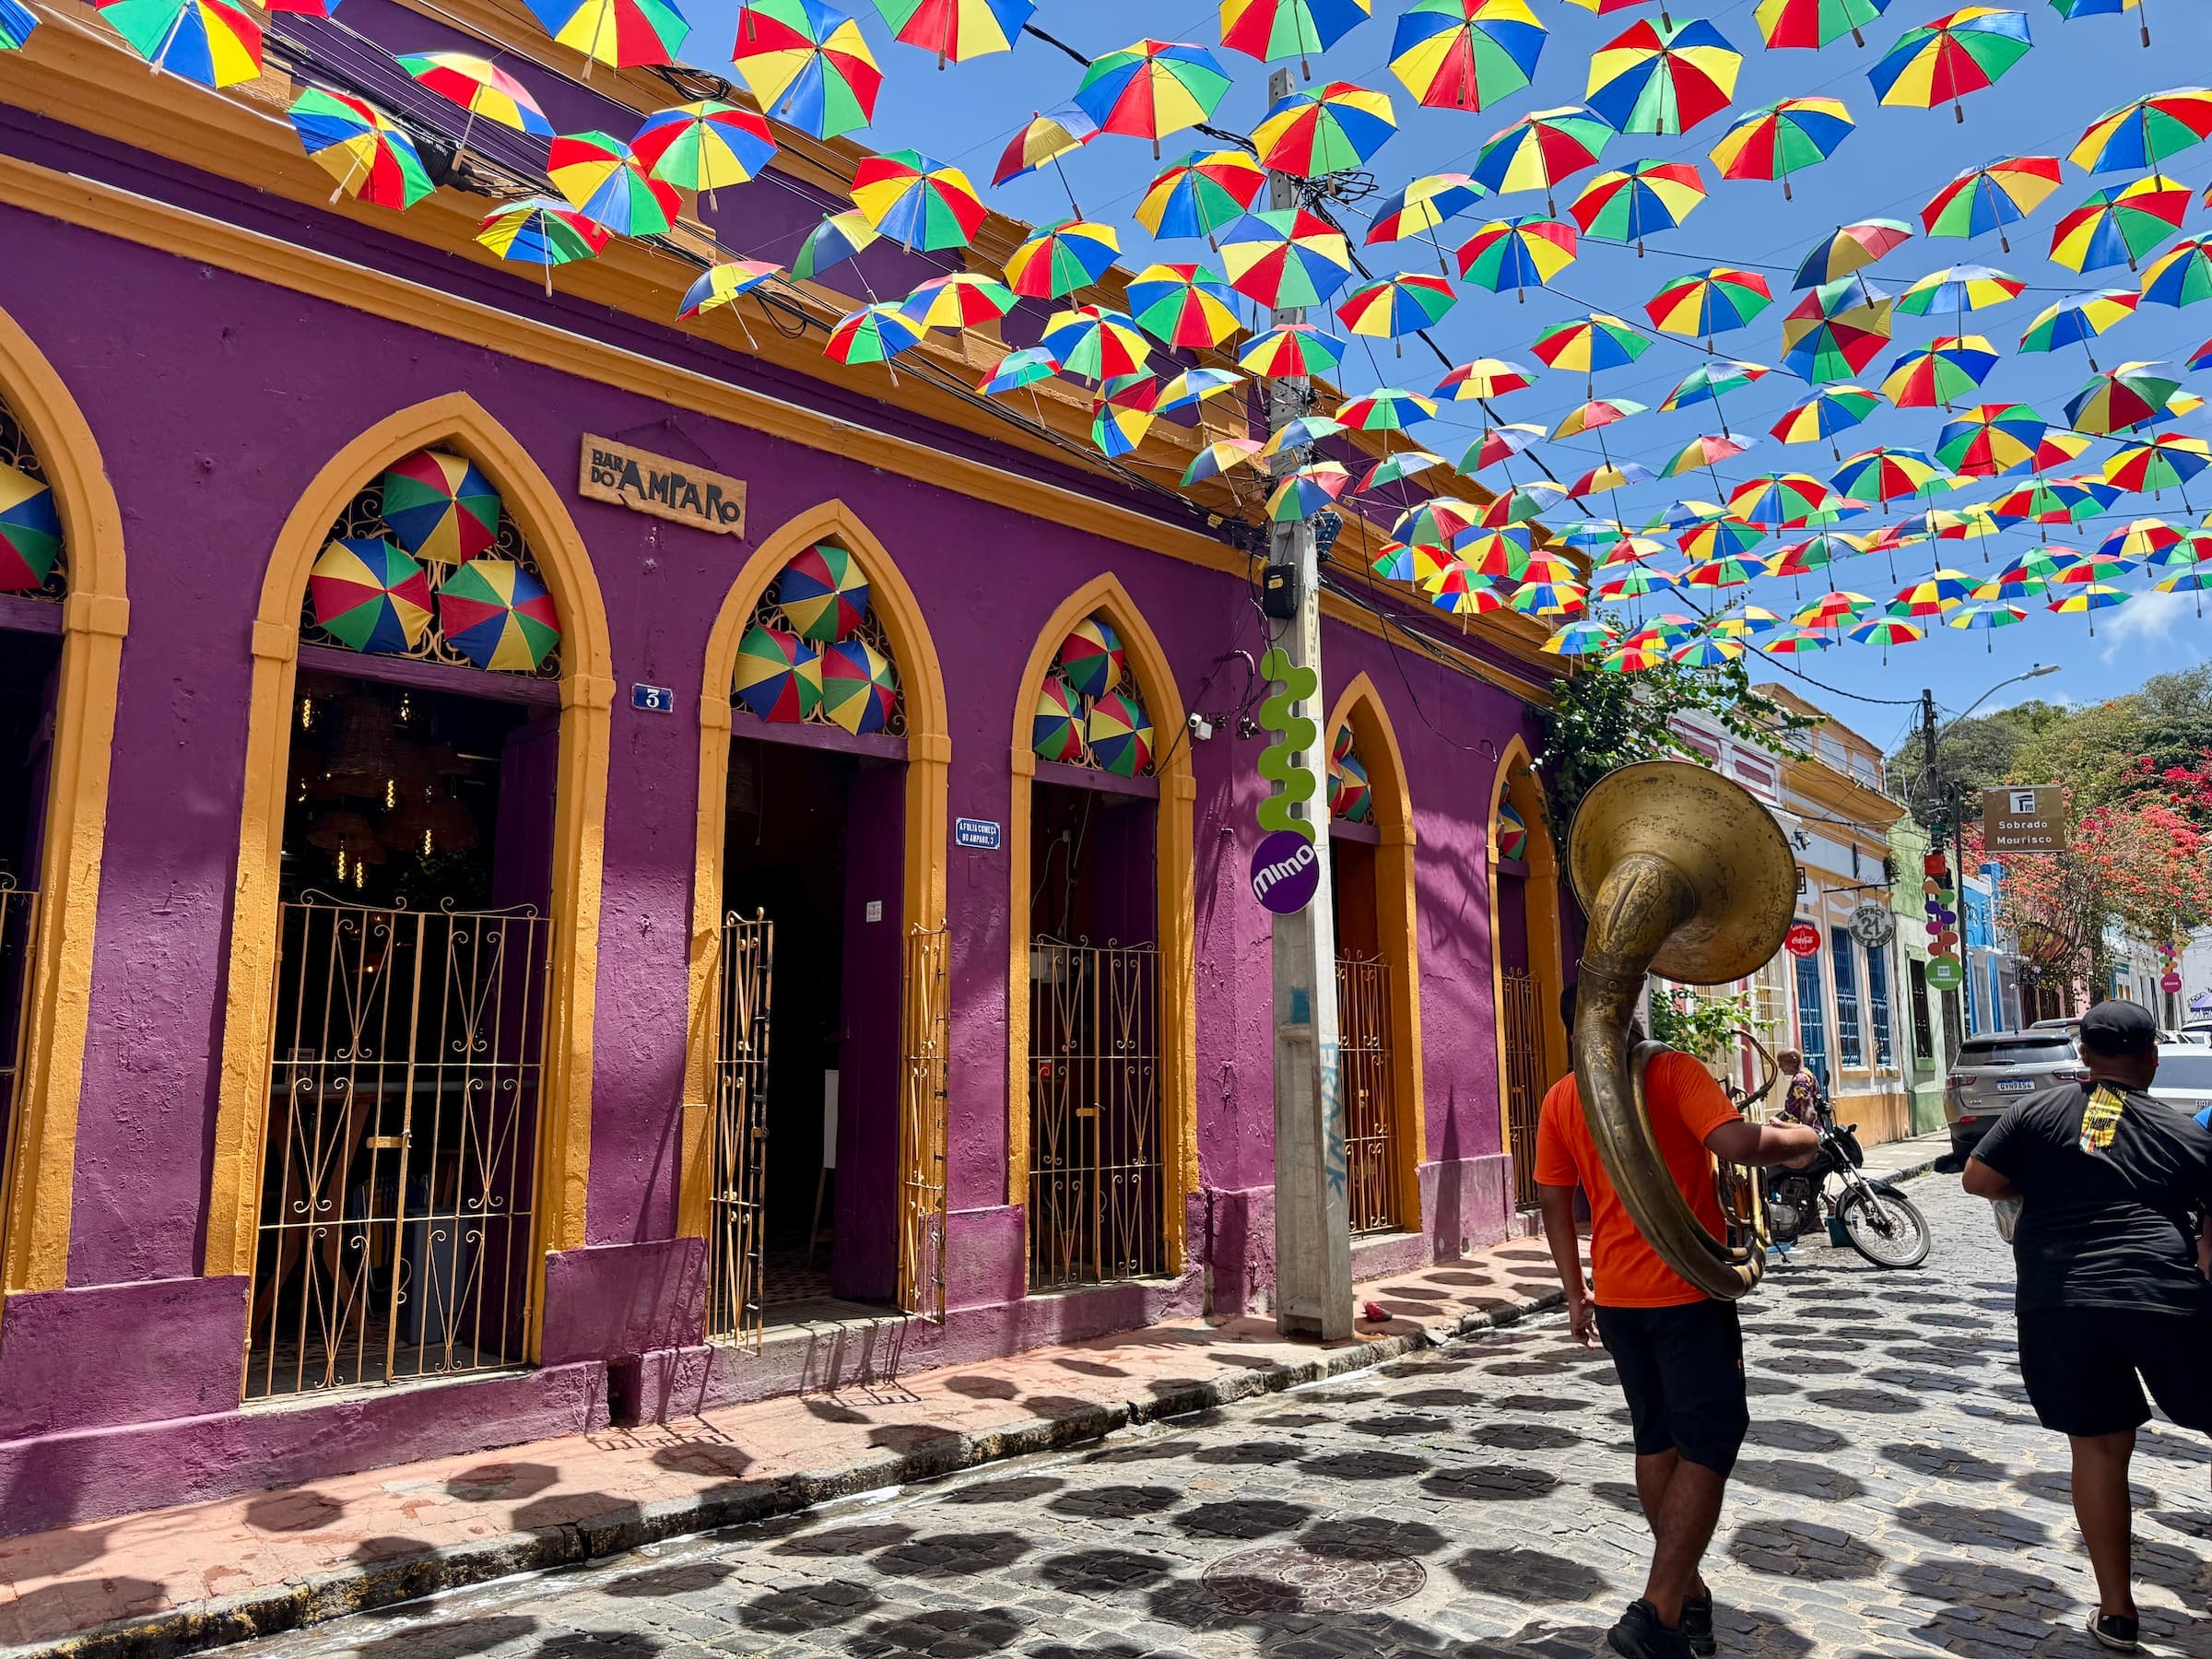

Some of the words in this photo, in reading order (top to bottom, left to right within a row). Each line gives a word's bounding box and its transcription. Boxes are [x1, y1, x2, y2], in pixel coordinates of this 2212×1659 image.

[592, 448, 624, 473] BAR
[591, 465, 616, 488] DO
[617, 459, 741, 524] AMPARO
[646, 688, 660, 708] 3
[1998, 820, 2048, 830] Sobrado
[1996, 835, 2053, 845] Mourisco
[1862, 917, 1881, 936] 21
